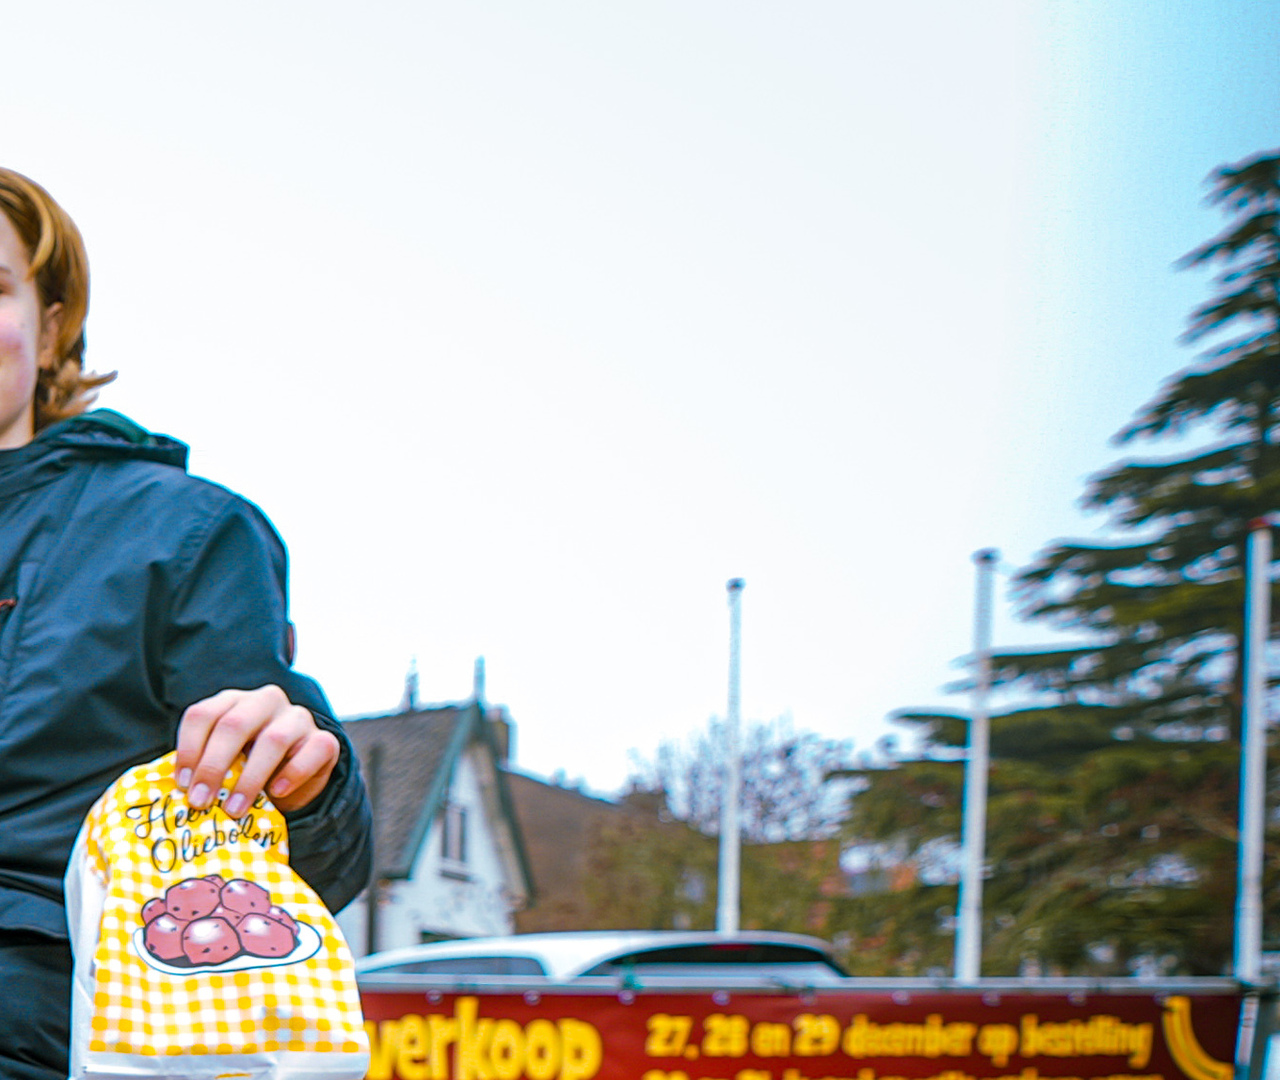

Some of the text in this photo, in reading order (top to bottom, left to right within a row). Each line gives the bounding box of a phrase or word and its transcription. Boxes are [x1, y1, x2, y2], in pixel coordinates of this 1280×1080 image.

[751, 1021, 790, 1057] en
[792, 1013, 840, 1057] 29
[842, 1013, 977, 1059] december
[978, 1023, 1018, 1068] op
[1020, 1013, 1153, 1070] bestelling
